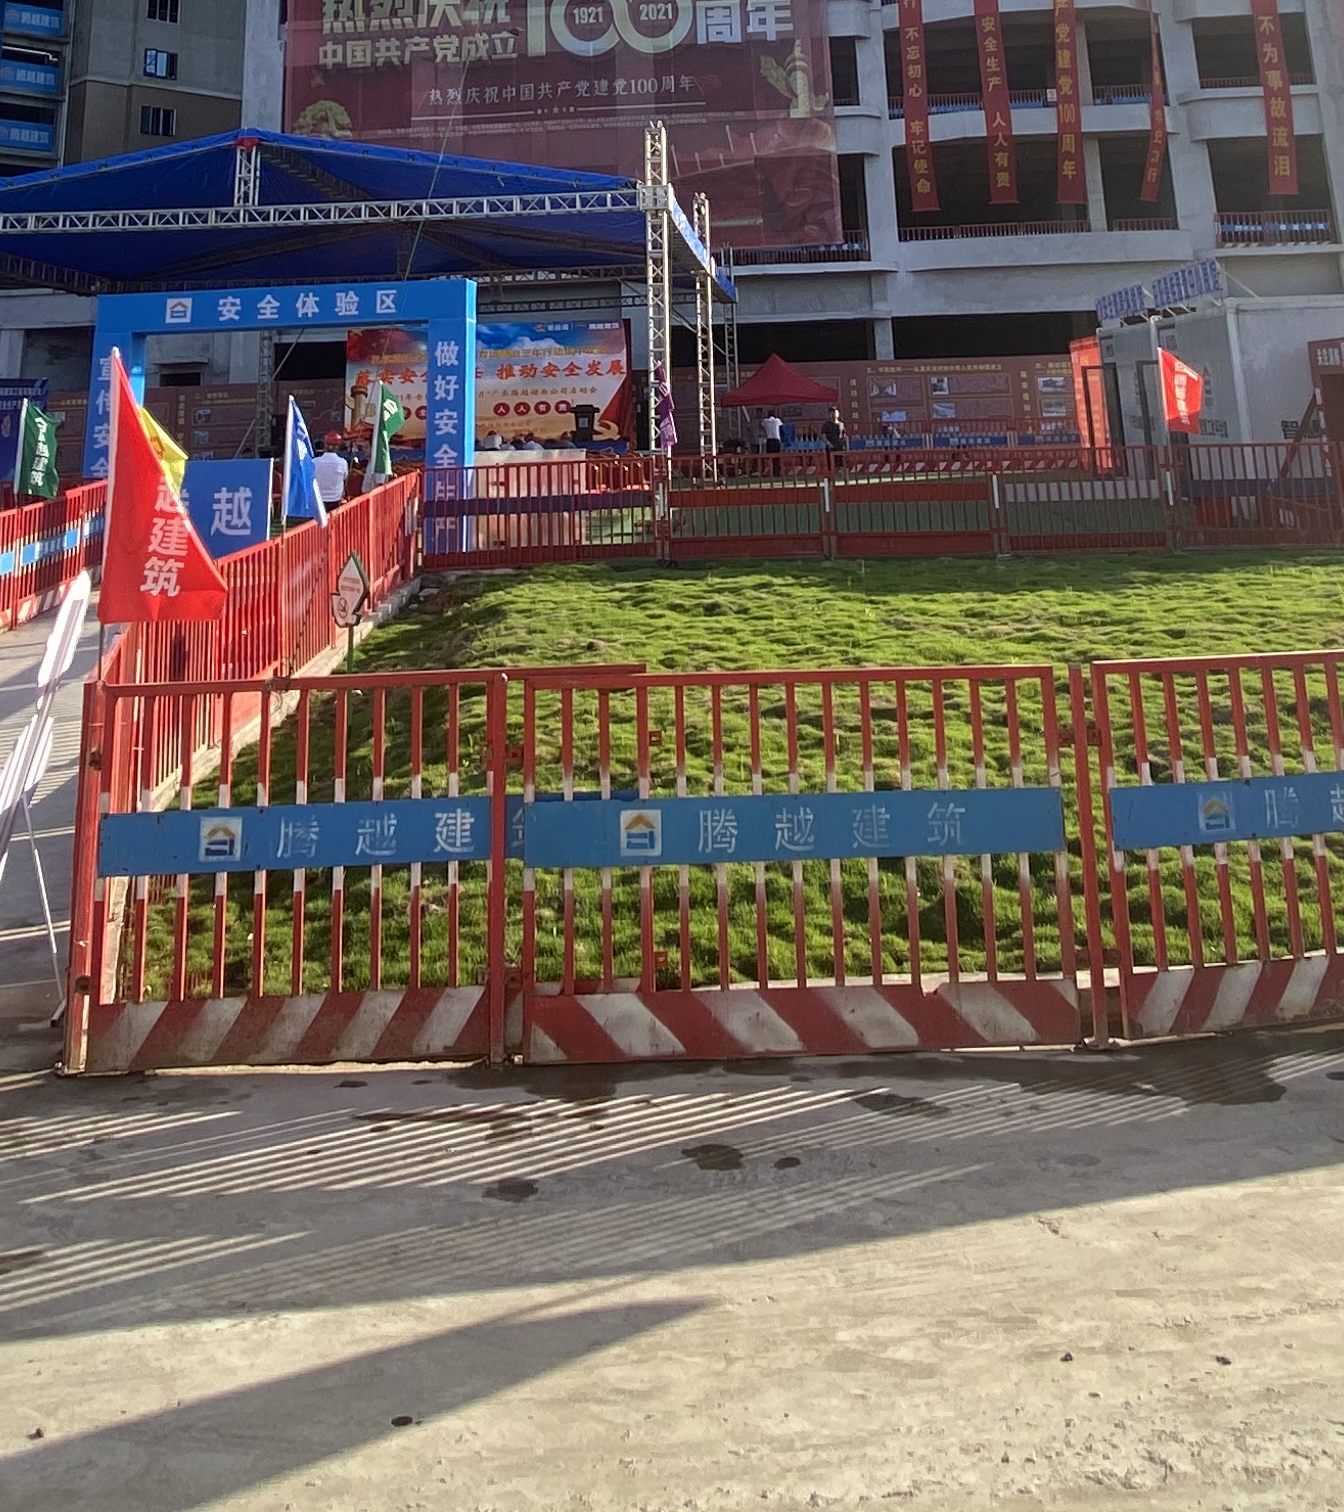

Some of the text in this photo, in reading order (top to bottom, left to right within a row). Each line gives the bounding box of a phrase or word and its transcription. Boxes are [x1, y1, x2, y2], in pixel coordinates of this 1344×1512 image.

[571, 6, 605, 25] 1921
[639, 3, 674, 22] 2021
[318, 30, 519, 70] 中国共产党成立
[905, 26, 924, 98] 不忘初心
[980, 16, 1002, 93] 安全生产
[428, 74, 697, 107] 热烈庆祝中国共产党建党100周年
[1258, 15, 1293, 178] 不为事故流泪
[909, 118, 932, 195] 牢记使命
[217, 289, 398, 322] 安全体验区
[496, 359, 626, 380] 推动安全发展
[497, 402, 569, 414] 人人有责
[697, 801, 966, 854] 腾越建筑
